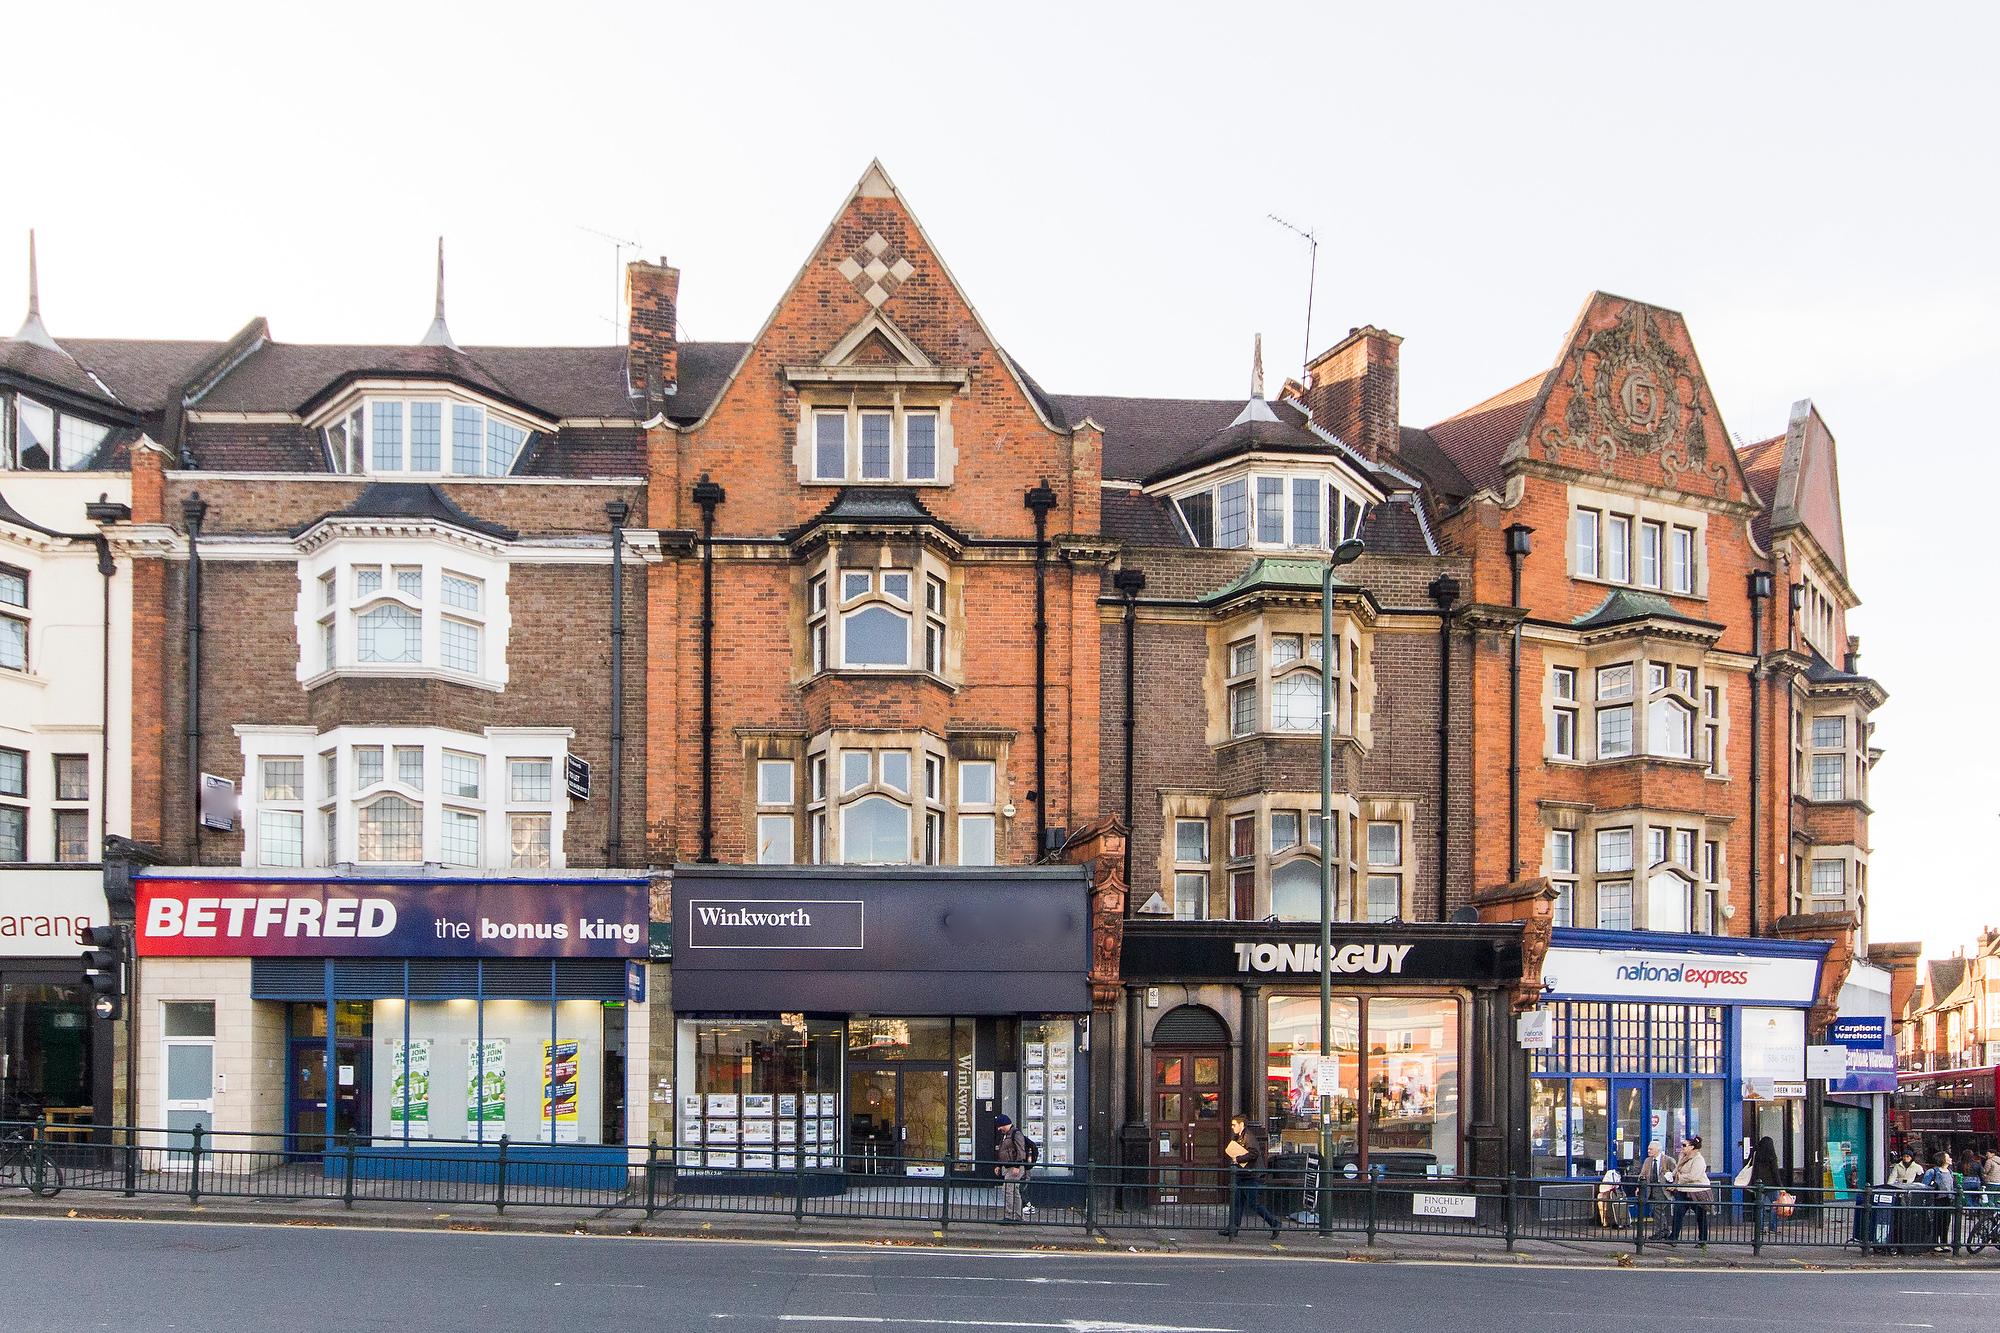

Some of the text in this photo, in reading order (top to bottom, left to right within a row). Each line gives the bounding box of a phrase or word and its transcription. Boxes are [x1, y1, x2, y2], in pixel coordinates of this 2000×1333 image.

[145, 897, 398, 938] BETFRED
[698, 906, 812, 927] Winkworth
[434, 917, 640, 944] the bonus king
[1234, 943, 1411, 974] TONI&GUY
[1616, 961, 1748, 988] national express
[1834, 1032, 1882, 1040] Warehouse
[1838, 1024, 1882, 1033] Carphone
[958, 1054, 972, 1136] Winkworth
[1791, 1086, 1803, 1094] ROAD
[1423, 1206, 1448, 1214] ROAD
[1424, 1196, 1465, 1206] FINCHLEY
